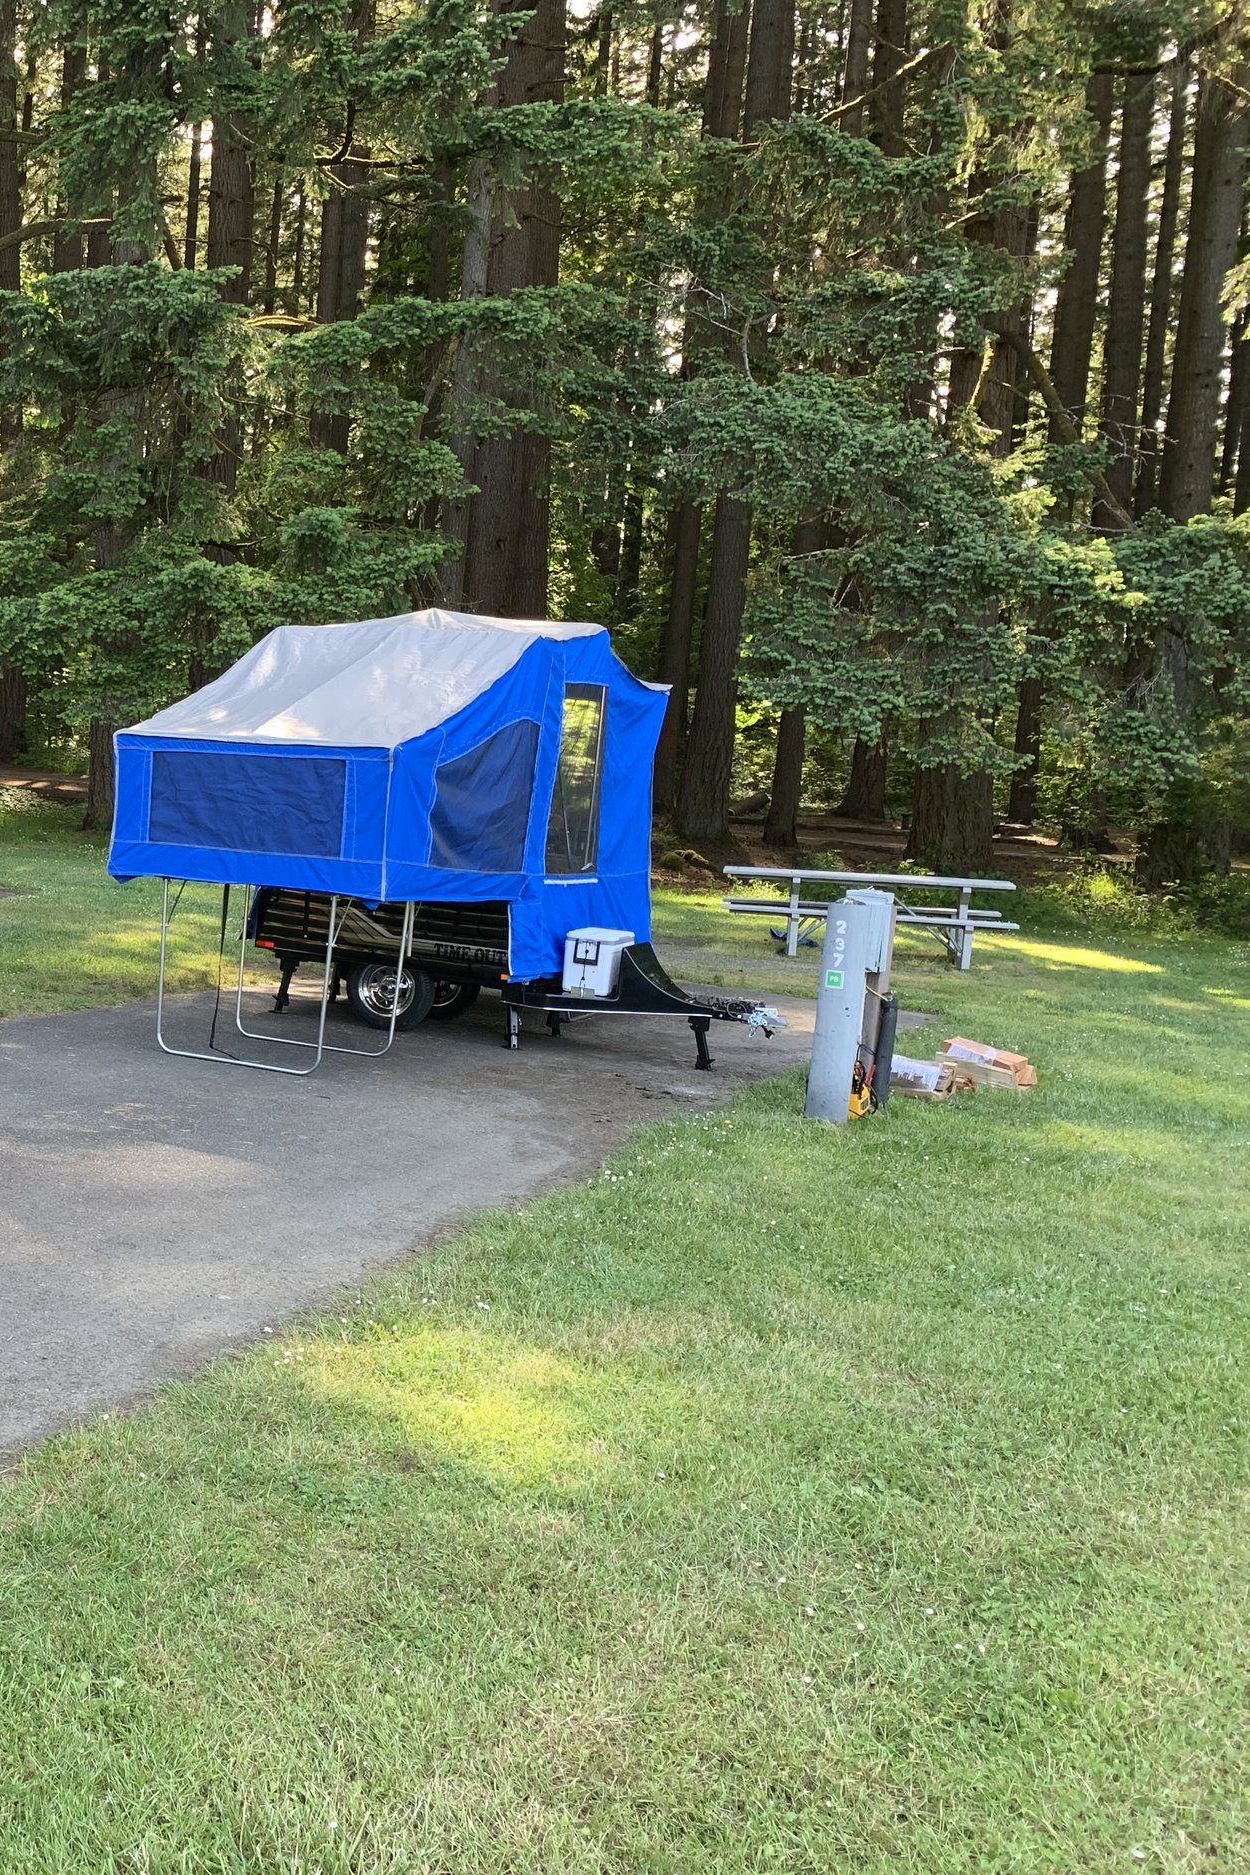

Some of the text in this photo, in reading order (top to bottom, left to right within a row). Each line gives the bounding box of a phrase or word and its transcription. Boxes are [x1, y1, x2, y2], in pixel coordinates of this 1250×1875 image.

[434, 943, 507, 964] TIME OUT
[833, 920, 847, 968] 237
